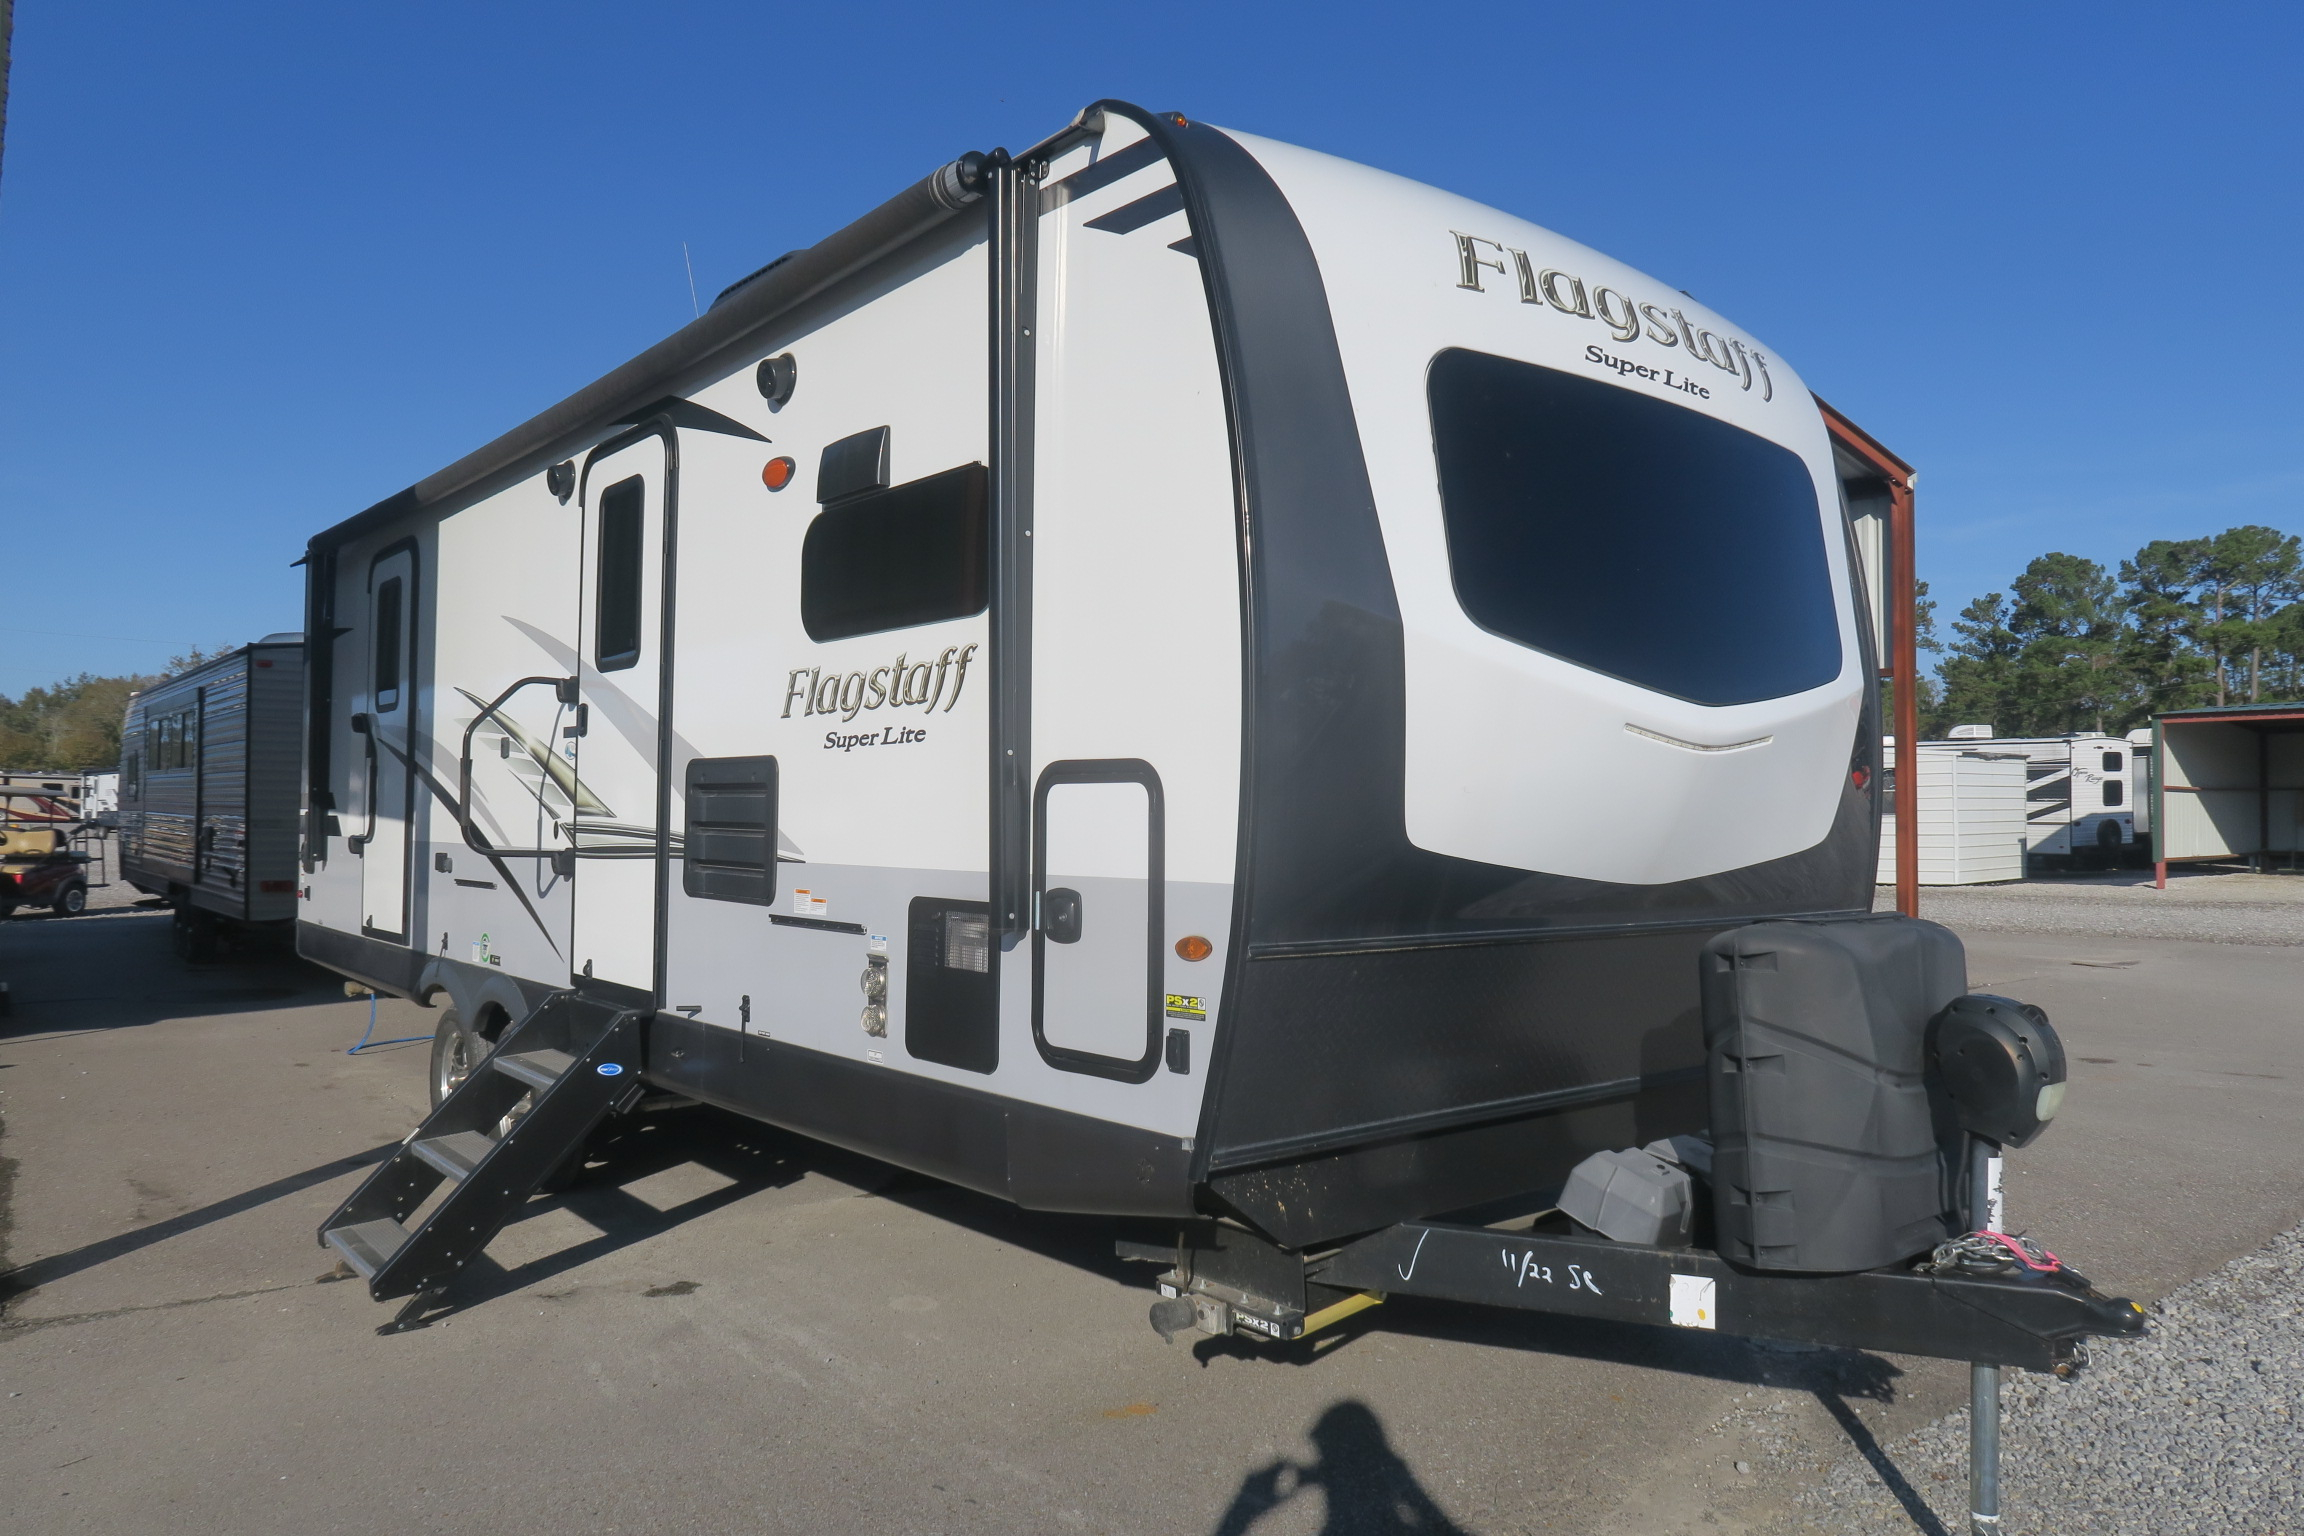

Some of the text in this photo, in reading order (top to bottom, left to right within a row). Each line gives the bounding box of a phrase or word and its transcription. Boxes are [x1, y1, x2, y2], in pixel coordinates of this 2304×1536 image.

[1449, 229, 1773, 402] Flagstaff
[1585, 344, 1710, 399] Super Lite
[780, 642, 979, 723] Flagstaff
[823, 726, 926, 752] Super Lite
[1166, 994, 1198, 1007] PSx2
[1501, 1248, 1553, 1287] 11/22
